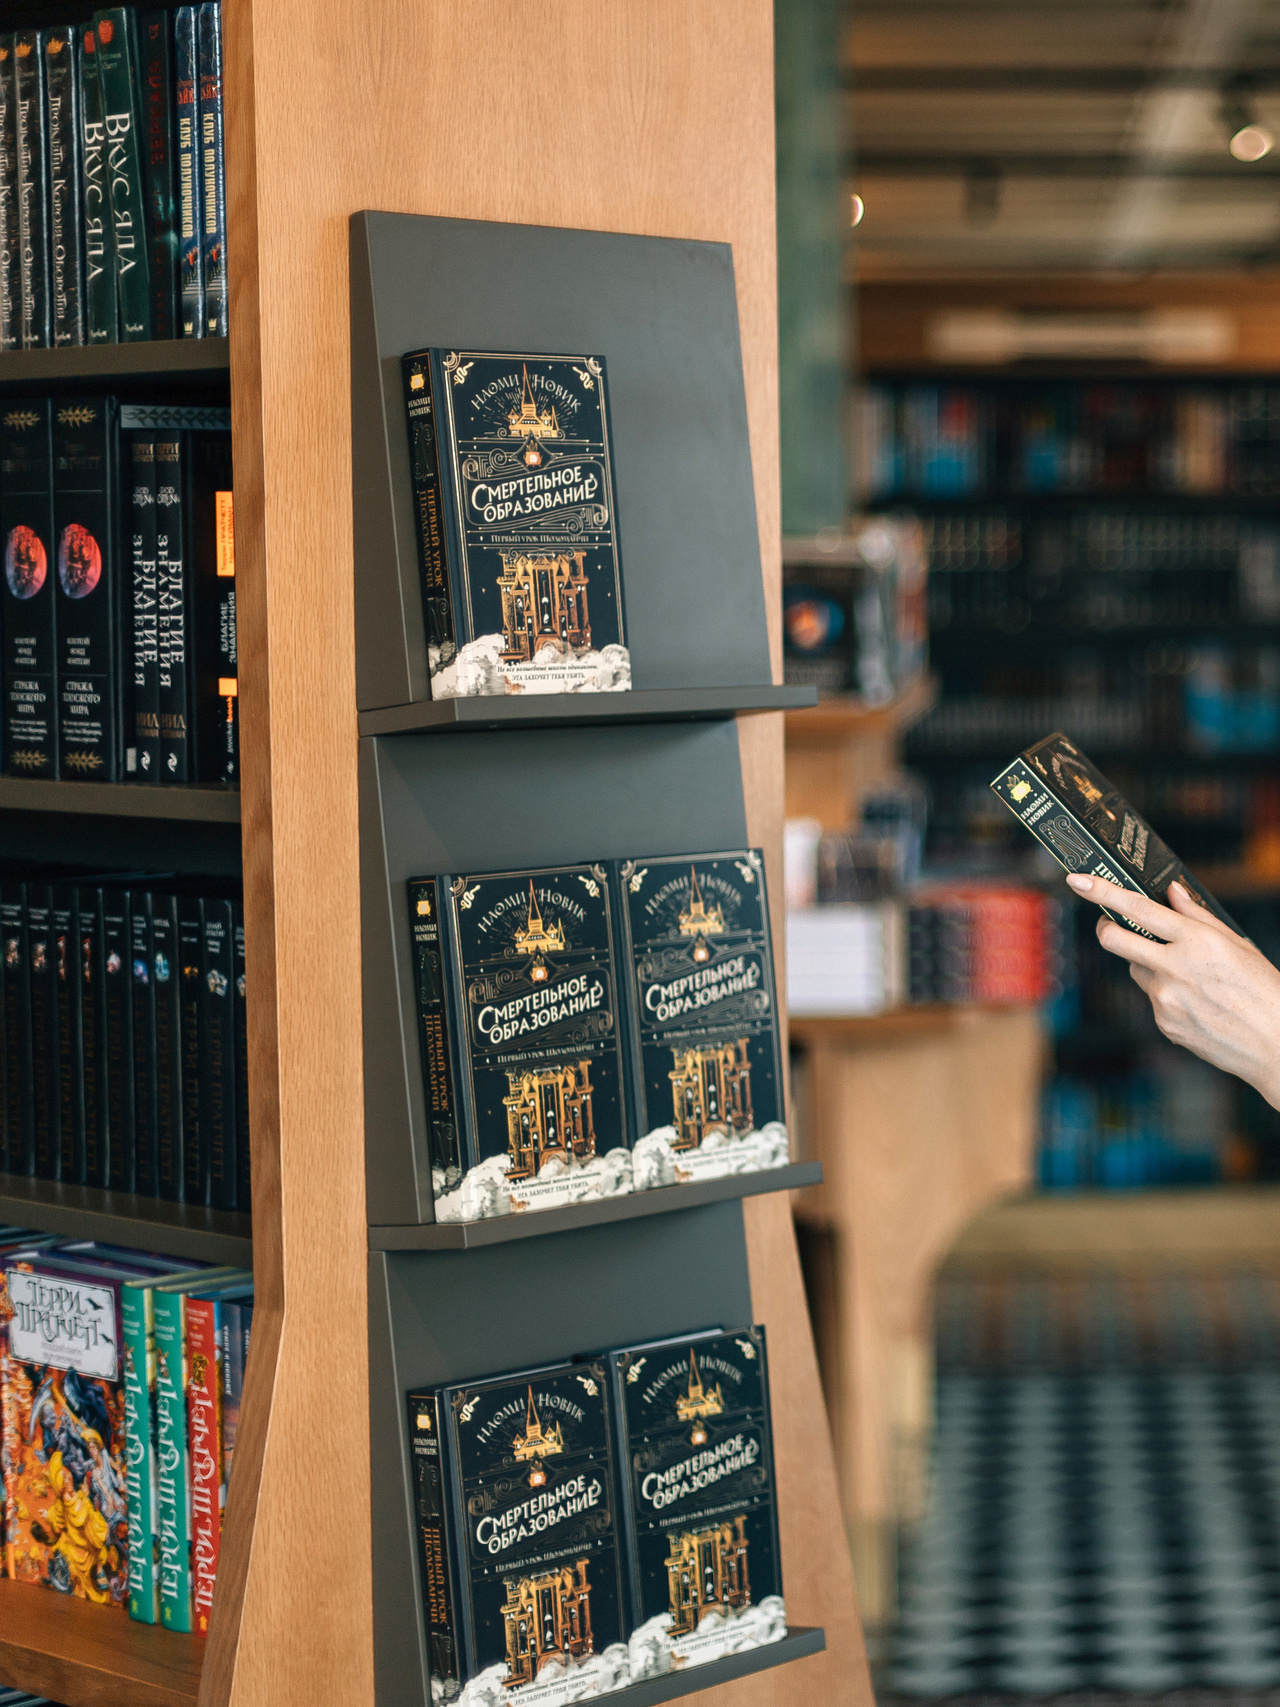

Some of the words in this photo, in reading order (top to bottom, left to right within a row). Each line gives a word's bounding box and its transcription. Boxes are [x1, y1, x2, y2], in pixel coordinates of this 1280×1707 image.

[180, 117, 192, 149] КЛУБ
[203, 112, 215, 144] КЛУБ
[180, 153, 194, 239] ПОЛУНОЧНИКОВ
[205, 148, 217, 235] ПОЛУНОЧНИКОВ
[409, 406, 431, 417] НОВИК
[470, 374, 520, 413] НАОМИ
[533, 374, 581, 414] НОВИК
[471, 466, 583, 511] СМЕРТЕЛЬНОЕ
[483, 473, 598, 523] ОБРАЗОВАНИЕ
[419, 491, 433, 588] ШОЛОМАНЧИ
[427, 489, 440, 546] ПЕРВЫЙ
[433, 550, 443, 588] УРОК
[132, 534, 145, 687] ЗНАМЕНИЯ
[143, 559, 158, 663] БЛАГИЕ
[157, 534, 171, 688] ЗНАМЕНИЯ
[168, 560, 185, 664] БЛАГИЕ
[1020, 792, 1049, 820] НАОМИ
[1026, 800, 1055, 826] НОВИК
[477, 890, 527, 933] НАОМИ
[540, 888, 587, 921] НОВИК
[644, 873, 689, 916] НАОМИ
[700, 872, 743, 907] НОВИК
[477, 974, 588, 1034] СМЕРТЕЛЬНОЕ
[645, 956, 746, 1012] СМЕРТЕЛЬНОЕ
[656, 962, 761, 1022] ОБРАЗОВАНИЕ
[489, 981, 603, 1044] ОБРАЗОВАНИЕ
[439, 1075, 449, 1112] УРОК
[27, 1279, 87, 1315] ТЕРРИ
[15, 1301, 102, 1350] ПРАТЧЕТТ
[642, 1361, 689, 1404] НАОМИ
[700, 1355, 743, 1384] НОВИК
[476, 1399, 526, 1444] НАОМИ
[538, 1392, 586, 1424] НОВИК
[641, 1434, 745, 1501] СМЕРТЕЛЬНОЕ
[652, 1438, 760, 1510] ОБРАЗОВАНИЕ
[476, 1474, 586, 1546] СМЕРТЕЛЬНОЕ
[487, 1478, 603, 1554] ОБРАЗОВАНИЕ
[160, 1509, 181, 1603] ТЕРРИ
[194, 1519, 217, 1614] ТЕРРИ
